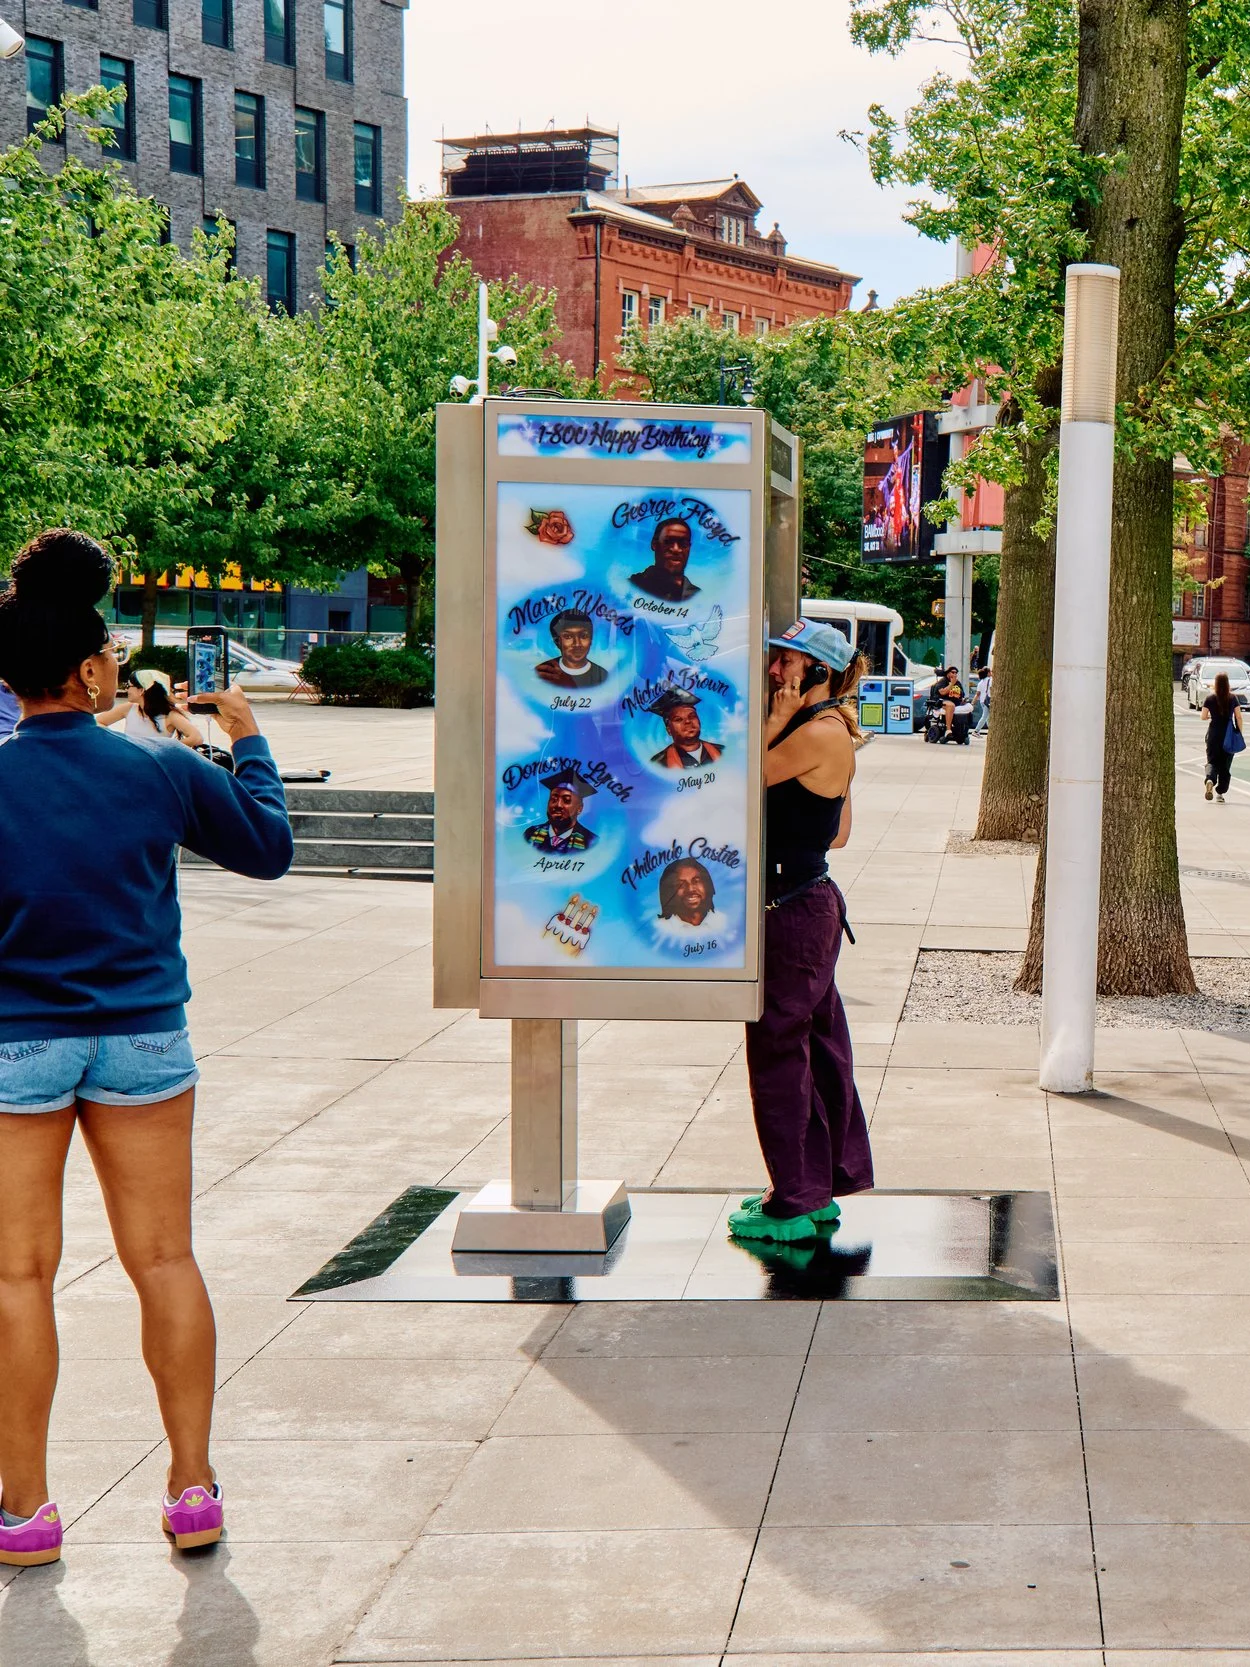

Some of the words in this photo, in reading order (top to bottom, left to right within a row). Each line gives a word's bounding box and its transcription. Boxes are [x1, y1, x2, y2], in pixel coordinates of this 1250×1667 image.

[538, 424, 588, 446] 1-800
[591, 421, 642, 455] Happy
[641, 424, 713, 458] Birthday
[611, 498, 676, 529] George
[678, 497, 741, 548] Floyd
[507, 595, 567, 635] Mario
[572, 589, 635, 637] Woods
[633, 597, 676, 616] October
[676, 607, 688, 618] 14
[550, 695, 577, 711] July
[576, 697, 592, 708] 22
[621, 669, 675, 719] Michael
[678, 667, 730, 696] Brown
[583, 759, 635, 803] Lynch
[676, 776, 704, 793] May
[703, 772, 716, 785] 20
[533, 857, 572, 873] April
[571, 860, 585, 873] 17
[621, 839, 683, 890] Philando
[687, 837, 740, 870] Castile
[682, 942, 707, 958] July
[706, 939, 718, 951] 16
